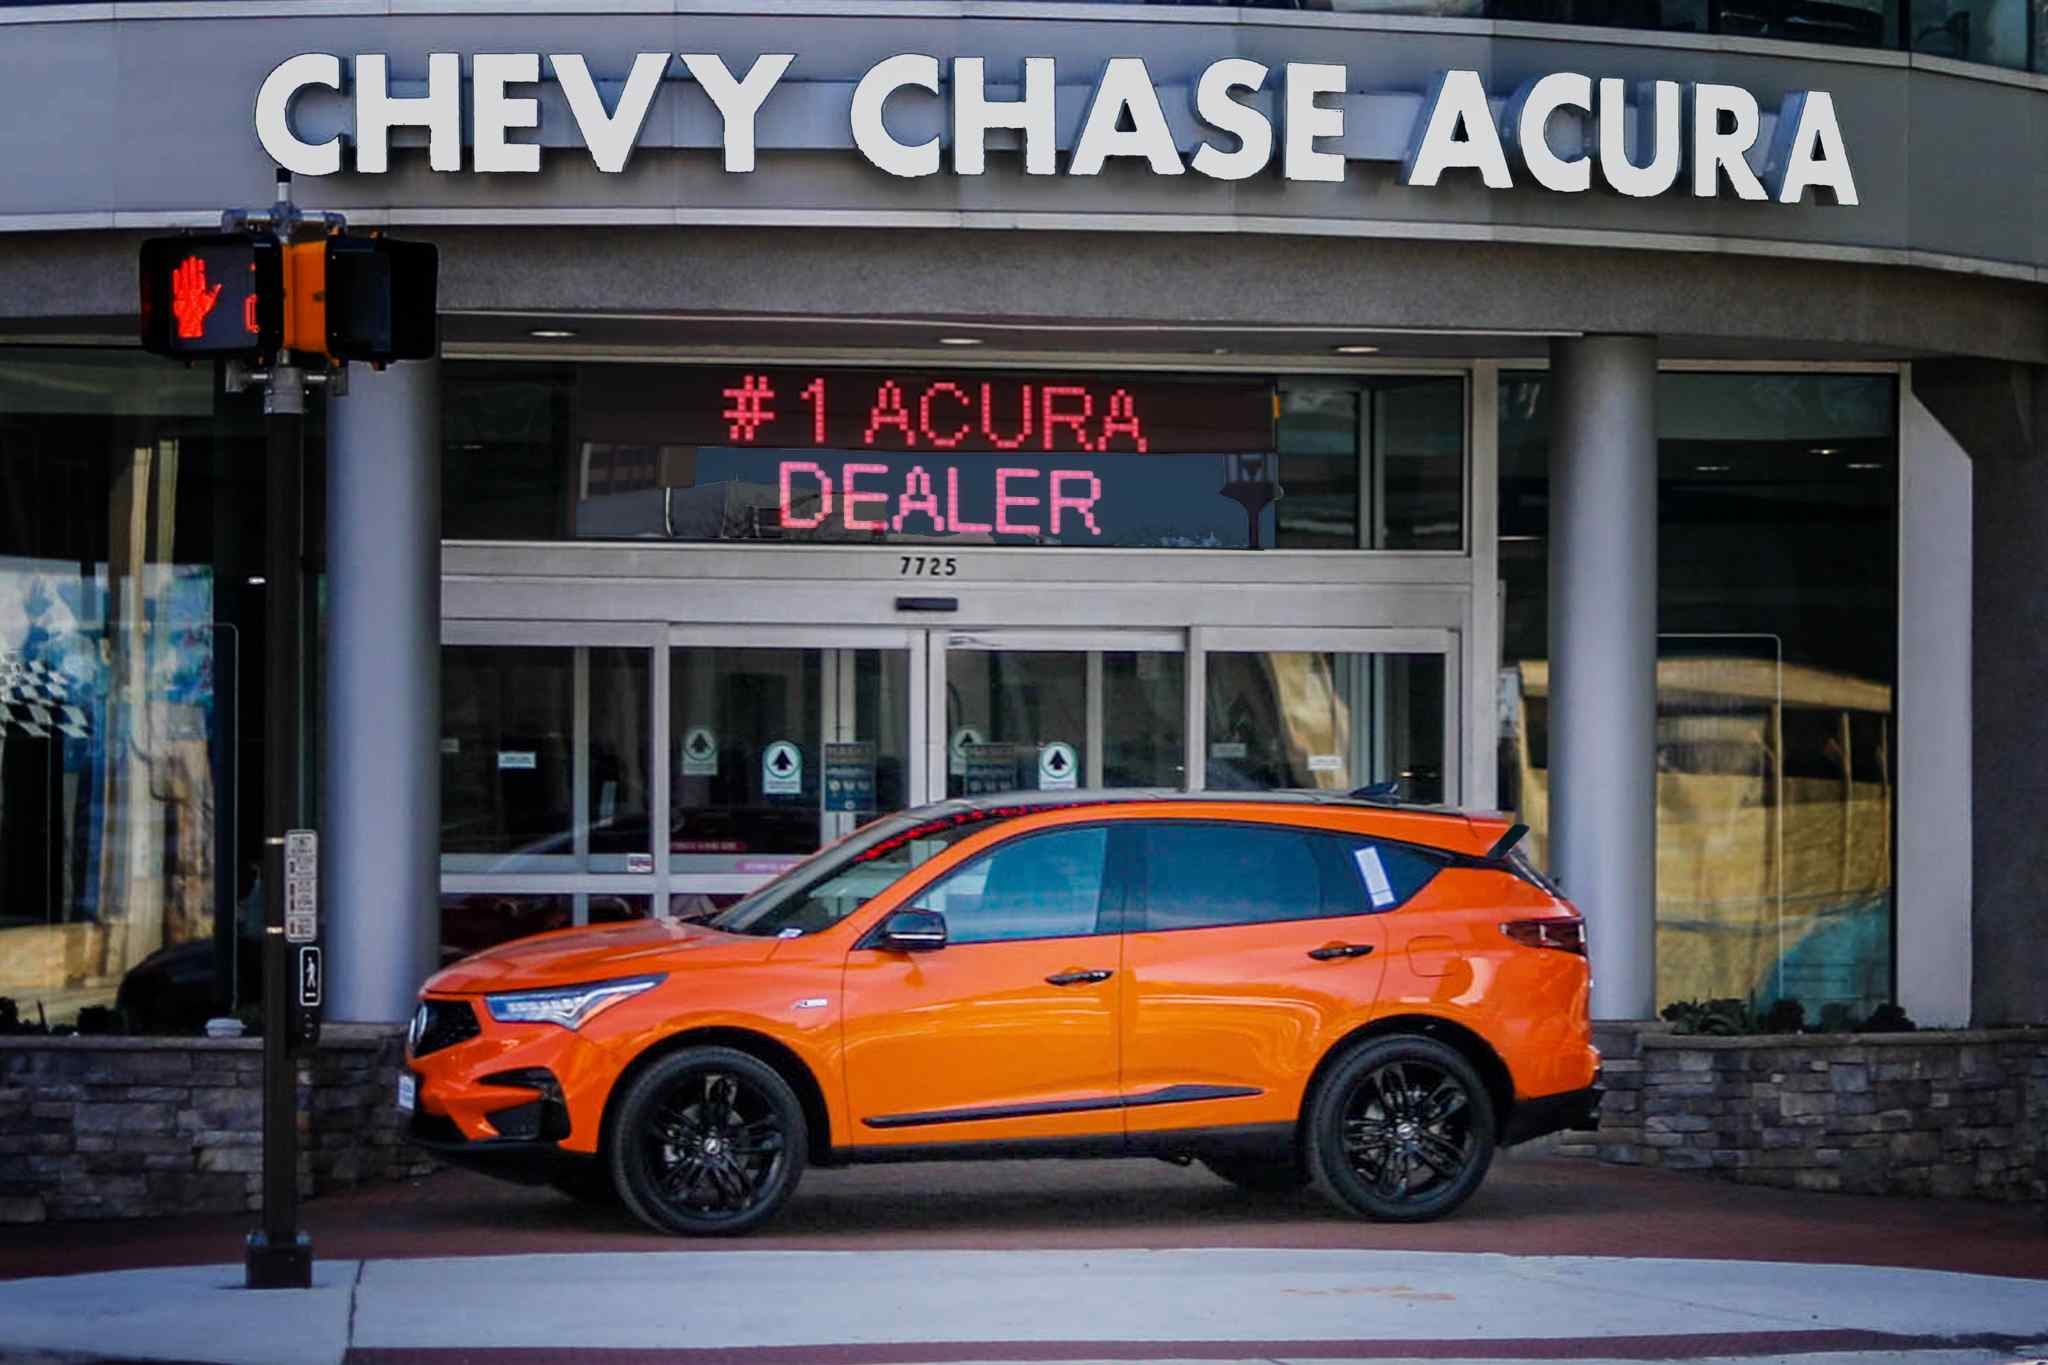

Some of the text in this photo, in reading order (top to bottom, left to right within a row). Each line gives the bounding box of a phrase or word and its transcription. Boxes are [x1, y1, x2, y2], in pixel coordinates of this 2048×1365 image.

[256, 53, 1858, 206] CHEVY CHASE ACURA
[864, 379, 1148, 454] ACURA
[778, 461, 1102, 535] DEALER
[900, 556, 957, 576] 7725
